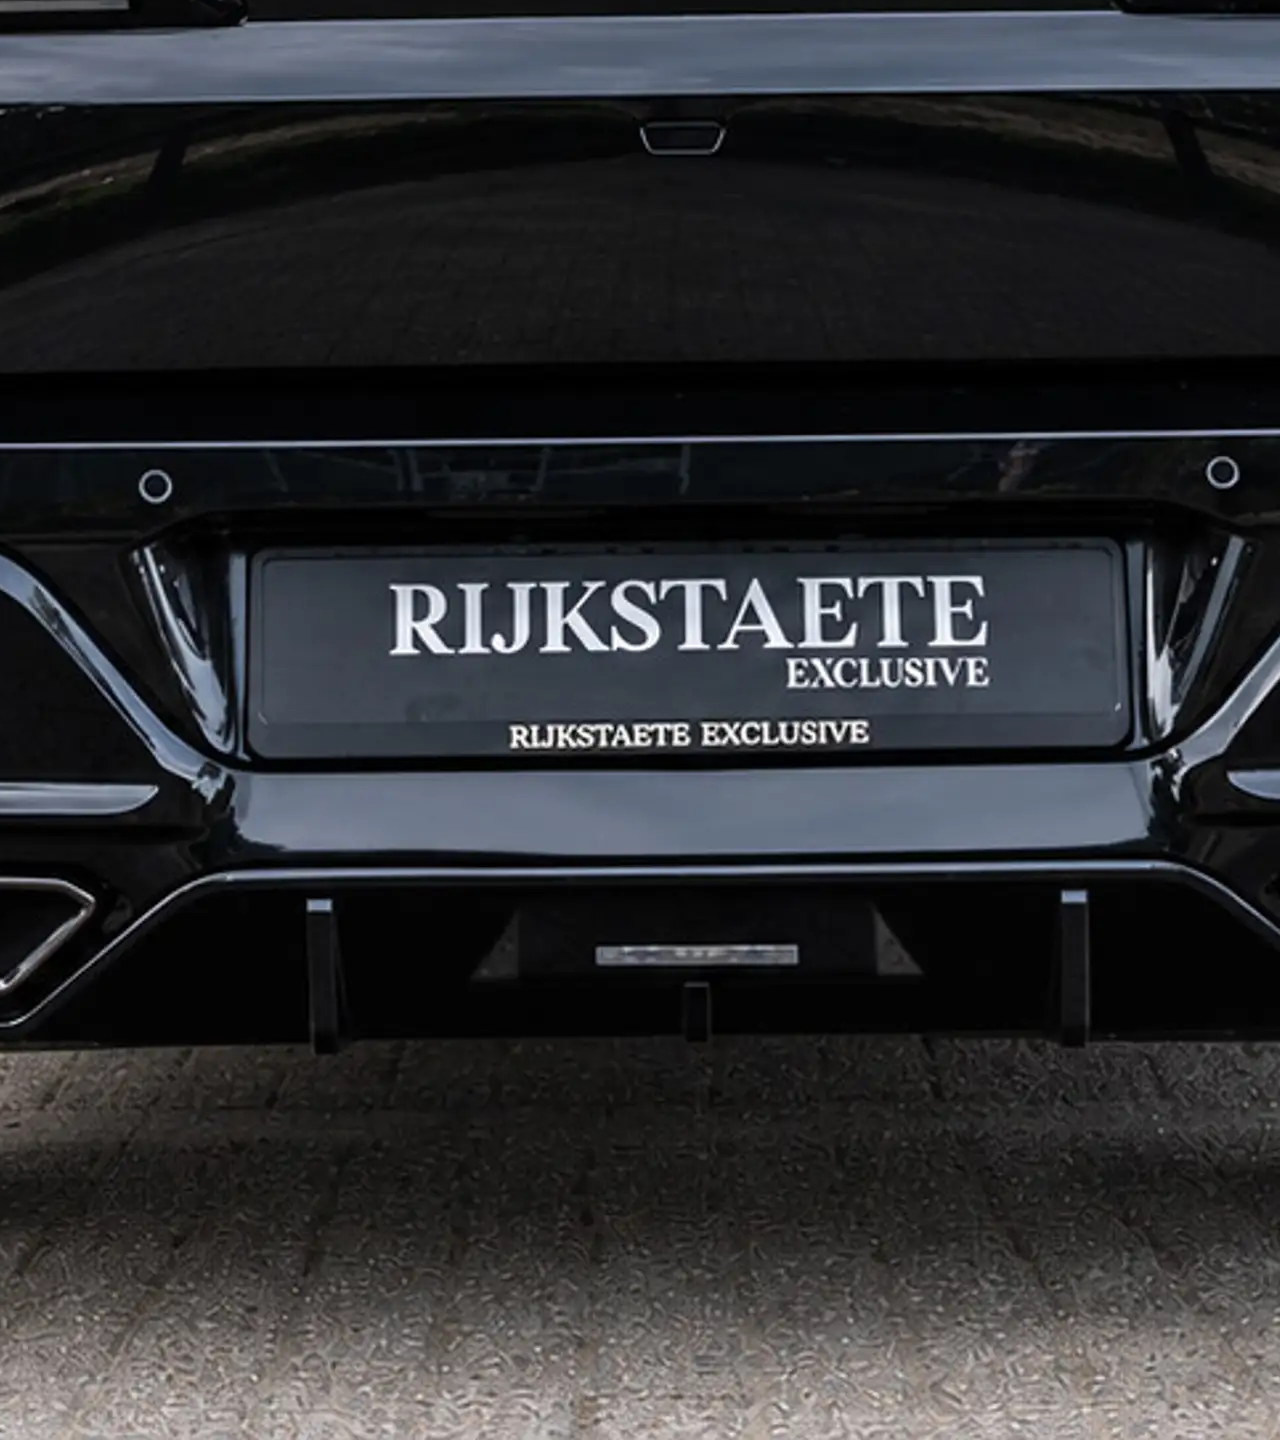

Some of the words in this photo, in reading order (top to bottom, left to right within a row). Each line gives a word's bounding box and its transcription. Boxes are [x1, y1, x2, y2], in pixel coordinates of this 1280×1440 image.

[388, 575, 989, 657] RIJKSTAETE
[785, 656, 991, 690] EXCLUSIVE
[509, 722, 692, 750] RIJKSTAETE
[700, 719, 871, 747] EXCLUSIVE
